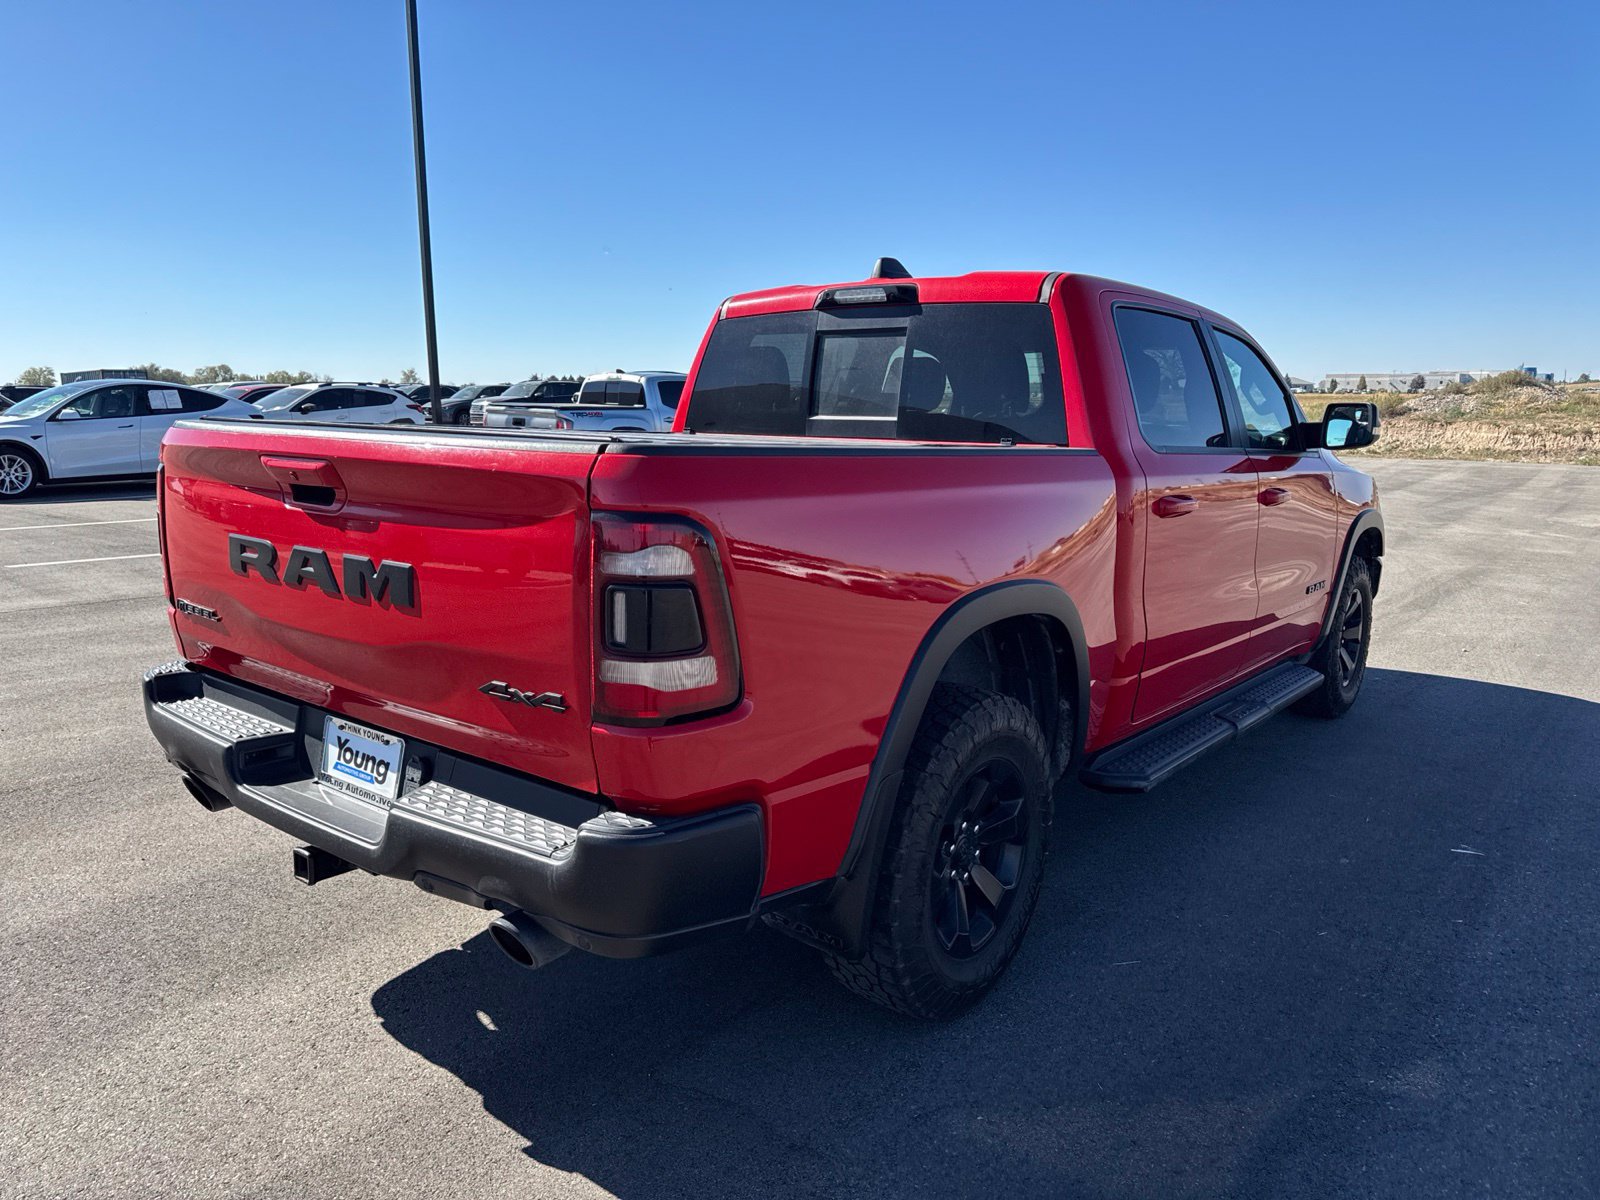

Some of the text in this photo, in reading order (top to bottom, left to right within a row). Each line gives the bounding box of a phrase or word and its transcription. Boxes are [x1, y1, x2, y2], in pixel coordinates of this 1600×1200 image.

[228, 532, 416, 609] RAM
[344, 723, 386, 743] THINK YOUNG
[336, 735, 390, 785] Young
[346, 784, 392, 807] Automoive
